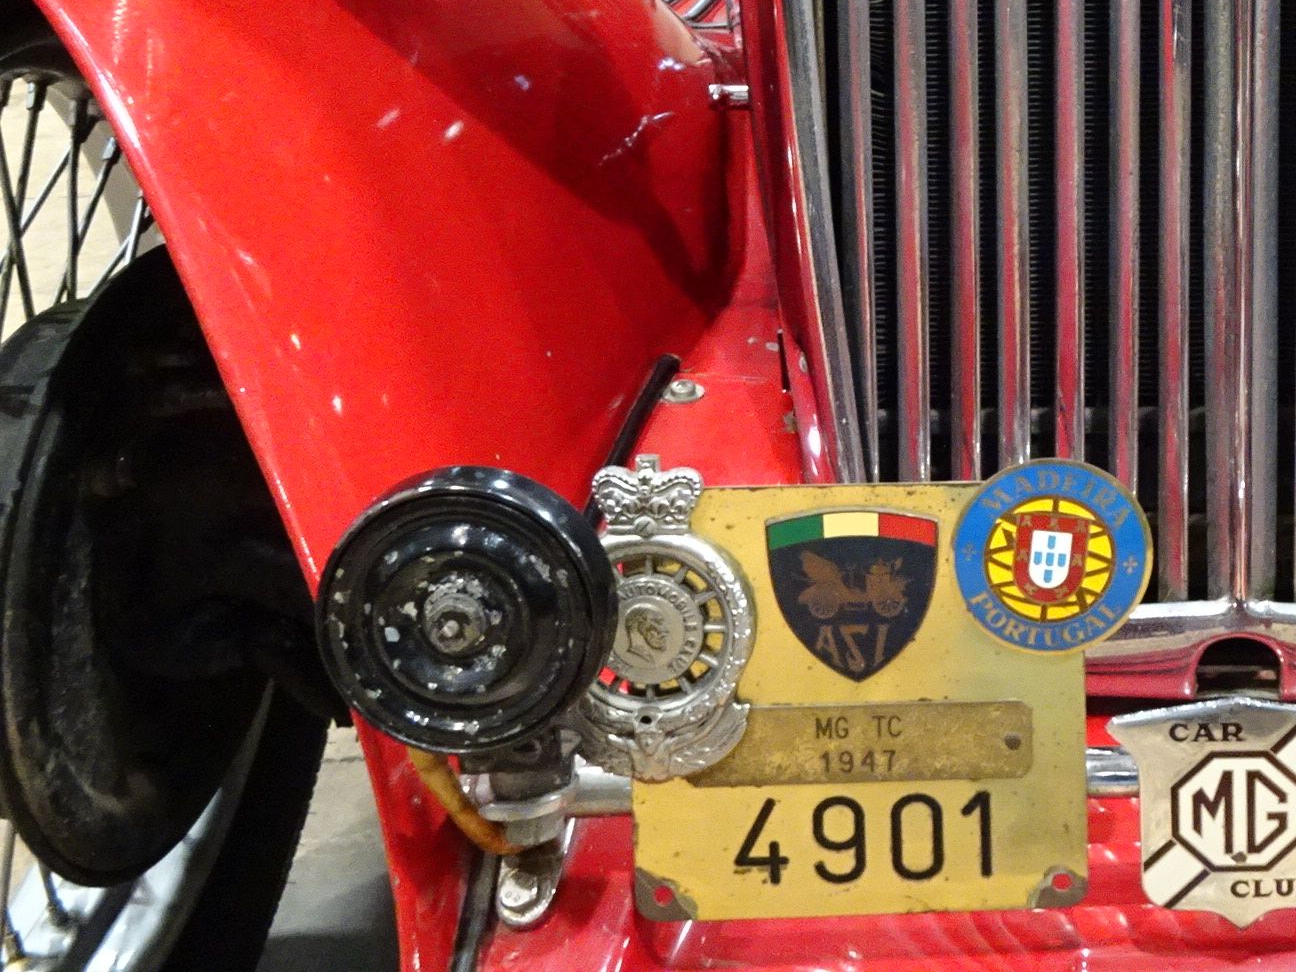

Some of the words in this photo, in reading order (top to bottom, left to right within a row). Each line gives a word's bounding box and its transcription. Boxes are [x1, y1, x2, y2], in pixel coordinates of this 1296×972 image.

[981, 470, 1131, 527] MADEIRA
[969, 591, 1120, 646] PORTUGAL
[815, 716, 850, 740] MG
[872, 715, 903, 738] TC
[1168, 722, 1246, 743] CAR
[819, 749, 897, 774] 1947
[733, 789, 993, 886] 4901
[1191, 769, 1289, 855] MG
